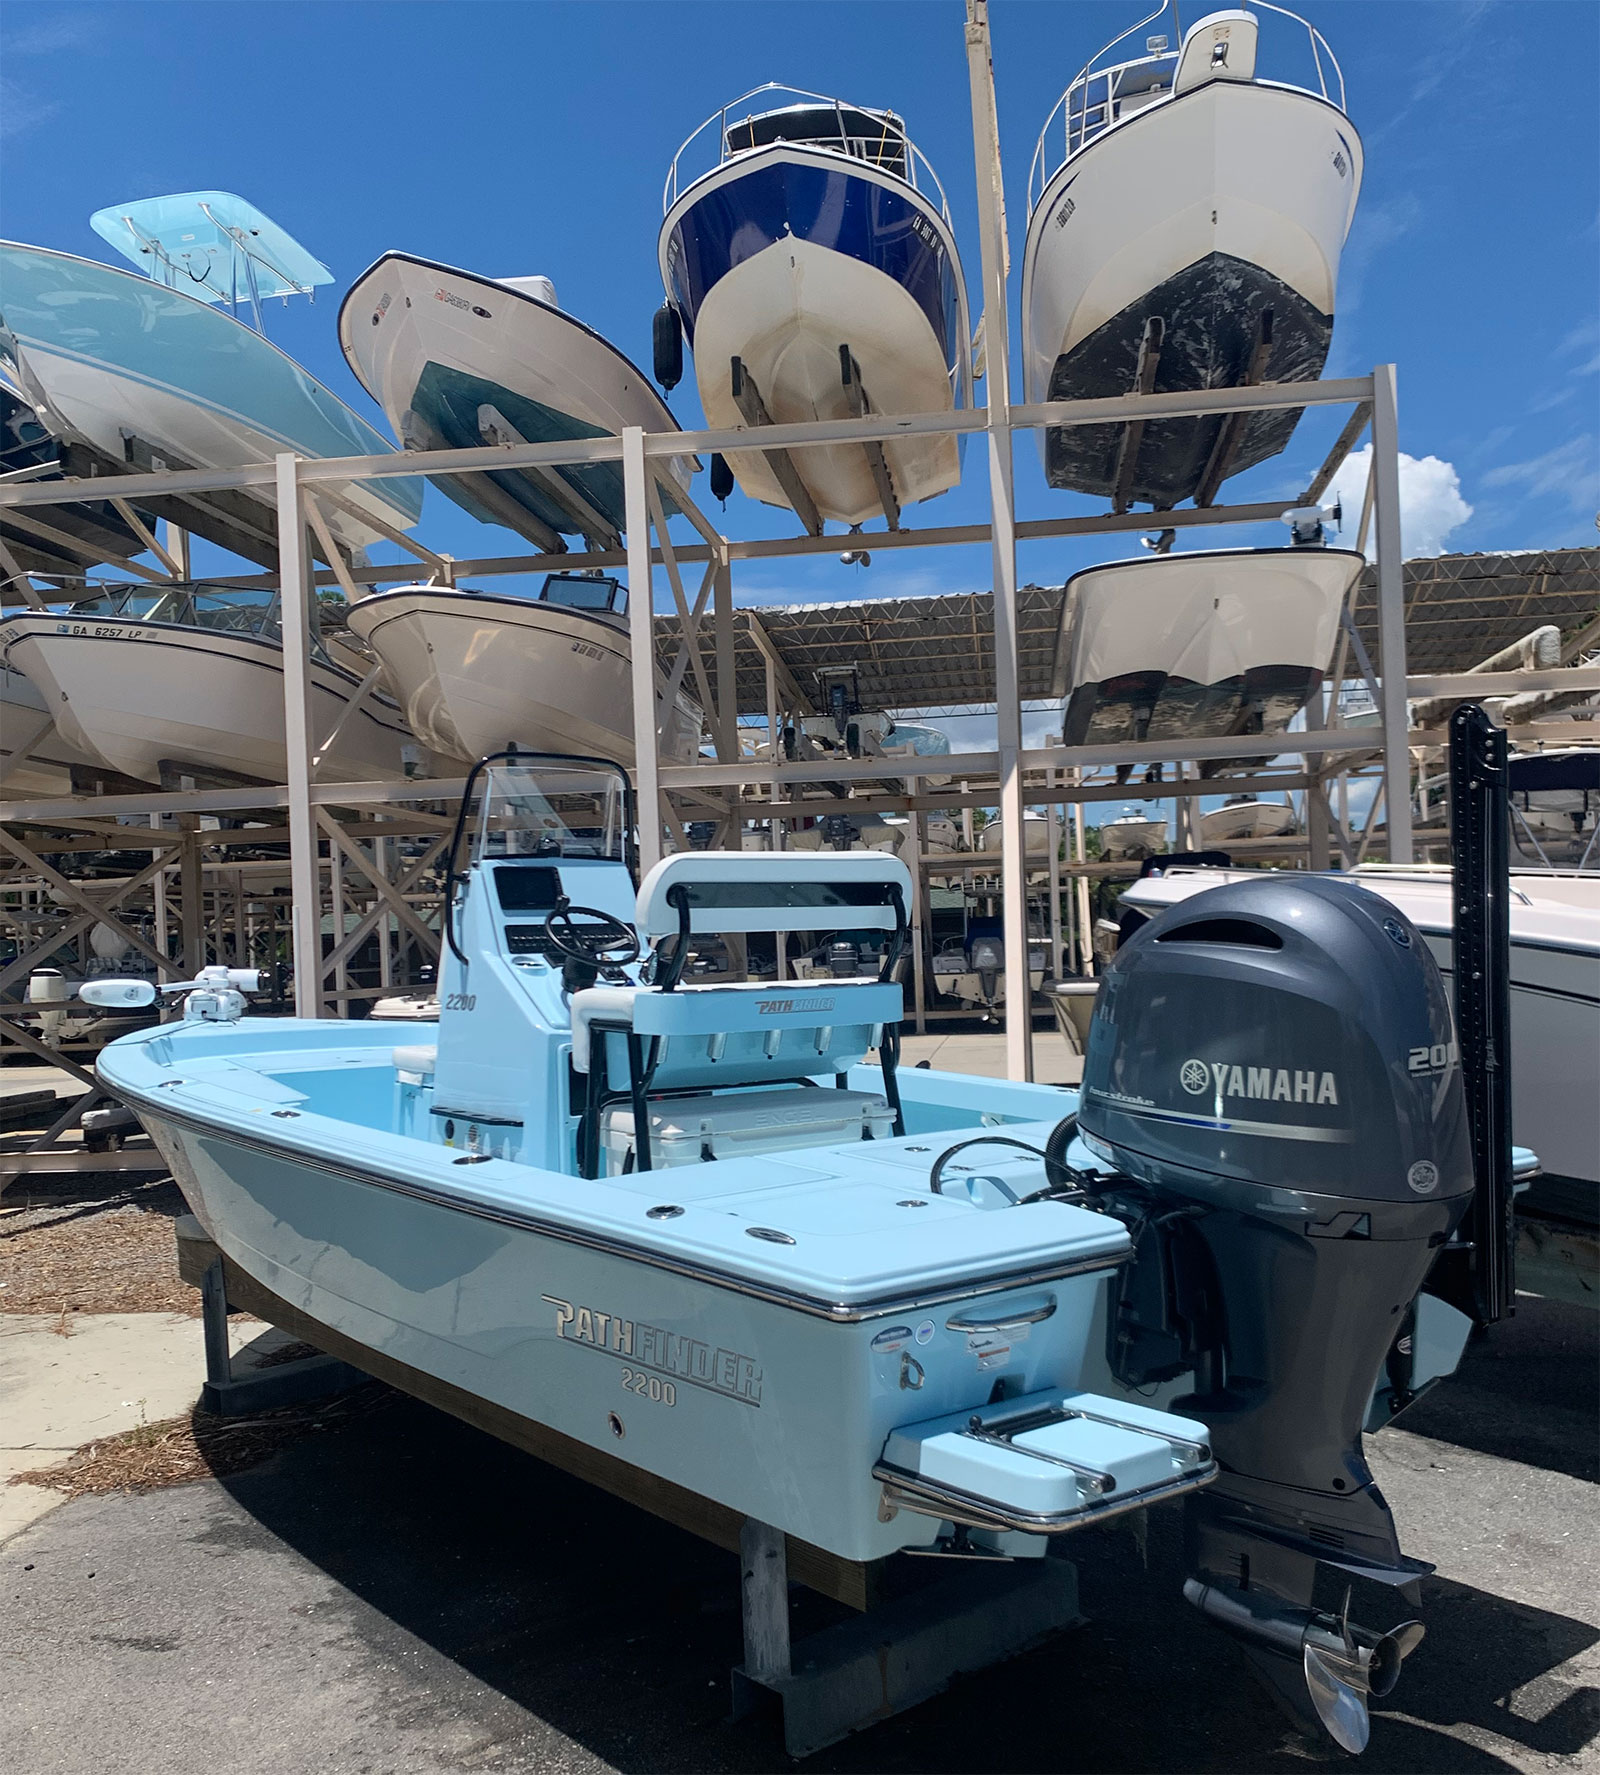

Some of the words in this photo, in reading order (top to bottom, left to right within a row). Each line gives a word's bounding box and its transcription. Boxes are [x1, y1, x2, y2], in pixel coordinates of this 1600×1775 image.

[73, 625, 87, 635] GA
[95, 627, 123, 637] 6257
[128, 630, 142, 639] LP
[446, 993, 477, 1011] 2200
[1211, 1063, 1339, 1105] YAMAHA
[541, 1293, 763, 1403] PATHFINDER
[620, 1366, 677, 1408] 2200
